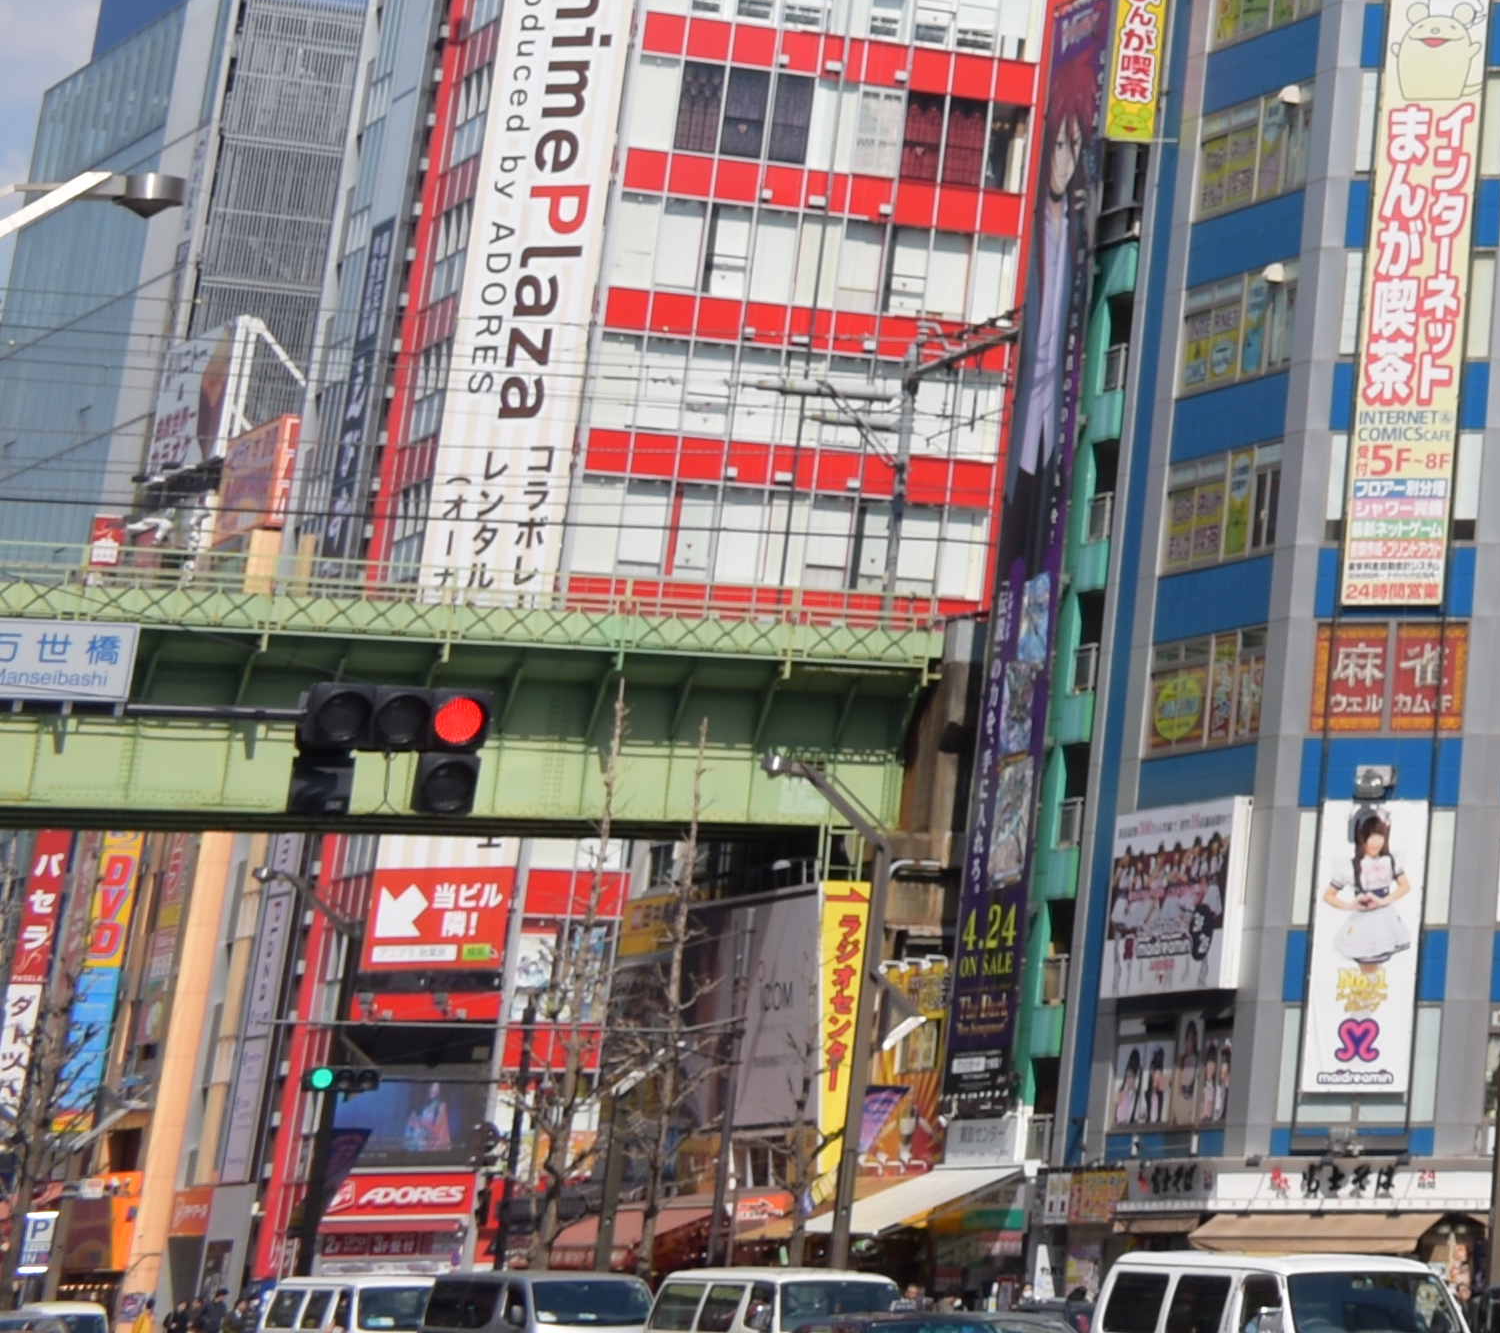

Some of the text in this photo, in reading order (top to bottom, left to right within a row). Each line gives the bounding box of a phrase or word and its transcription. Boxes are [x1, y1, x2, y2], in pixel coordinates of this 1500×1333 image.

[495, 151, 531, 205] by
[1362, 103, 1432, 407] まんが喫茶
[1416, 101, 1477, 407] インターネット
[465, 220, 517, 397] ADORES
[1357, 427, 1423, 443] COMICS
[1358, 410, 1439, 426] INTERNET
[1345, 582, 1440, 601] 24時間営業
[1331, 642, 1450, 689] 麻雀
[22, 852, 61, 951] パセラ
[90, 854, 135, 959] DVD
[431, 882, 504, 910] 当ビル
[961, 901, 1019, 953] 4.24
[959, 951, 1014, 978] ON SALE
[823, 913, 865, 1093] ラジオセンター
[358, 1184, 468, 1207] ADORES
